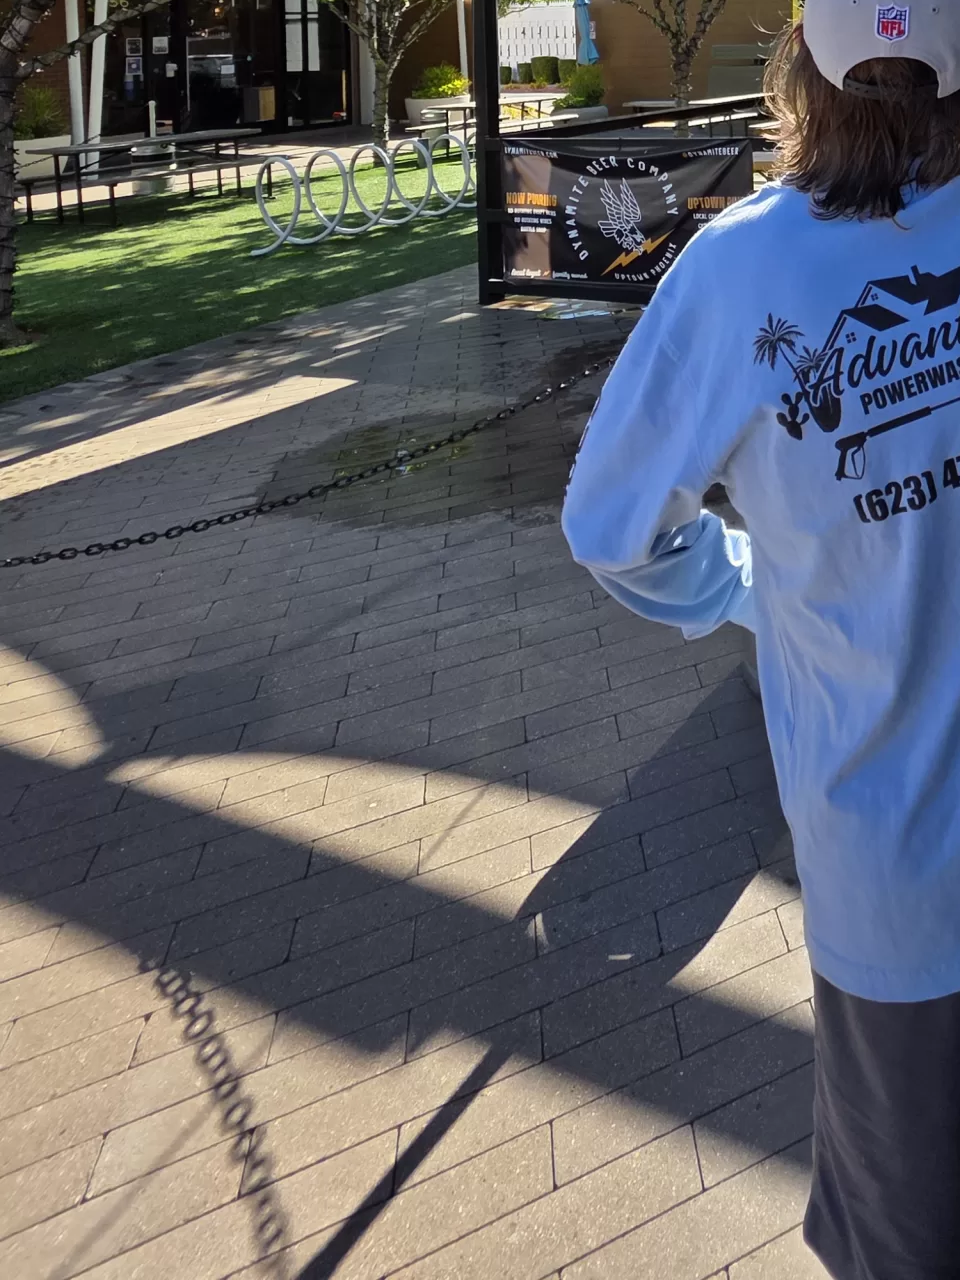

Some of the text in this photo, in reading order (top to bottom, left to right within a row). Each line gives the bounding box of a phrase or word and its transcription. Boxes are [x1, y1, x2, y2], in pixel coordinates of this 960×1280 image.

[880, 20, 905, 38] NFL
[506, 192, 525, 205] NOW
[565, 156, 679, 261] DYNAMITE BEER COMPANY
[687, 196, 725, 210] UPTOWN
[650, 242, 677, 276] PHOENIX
[853, 470, 938, 524] (623)
